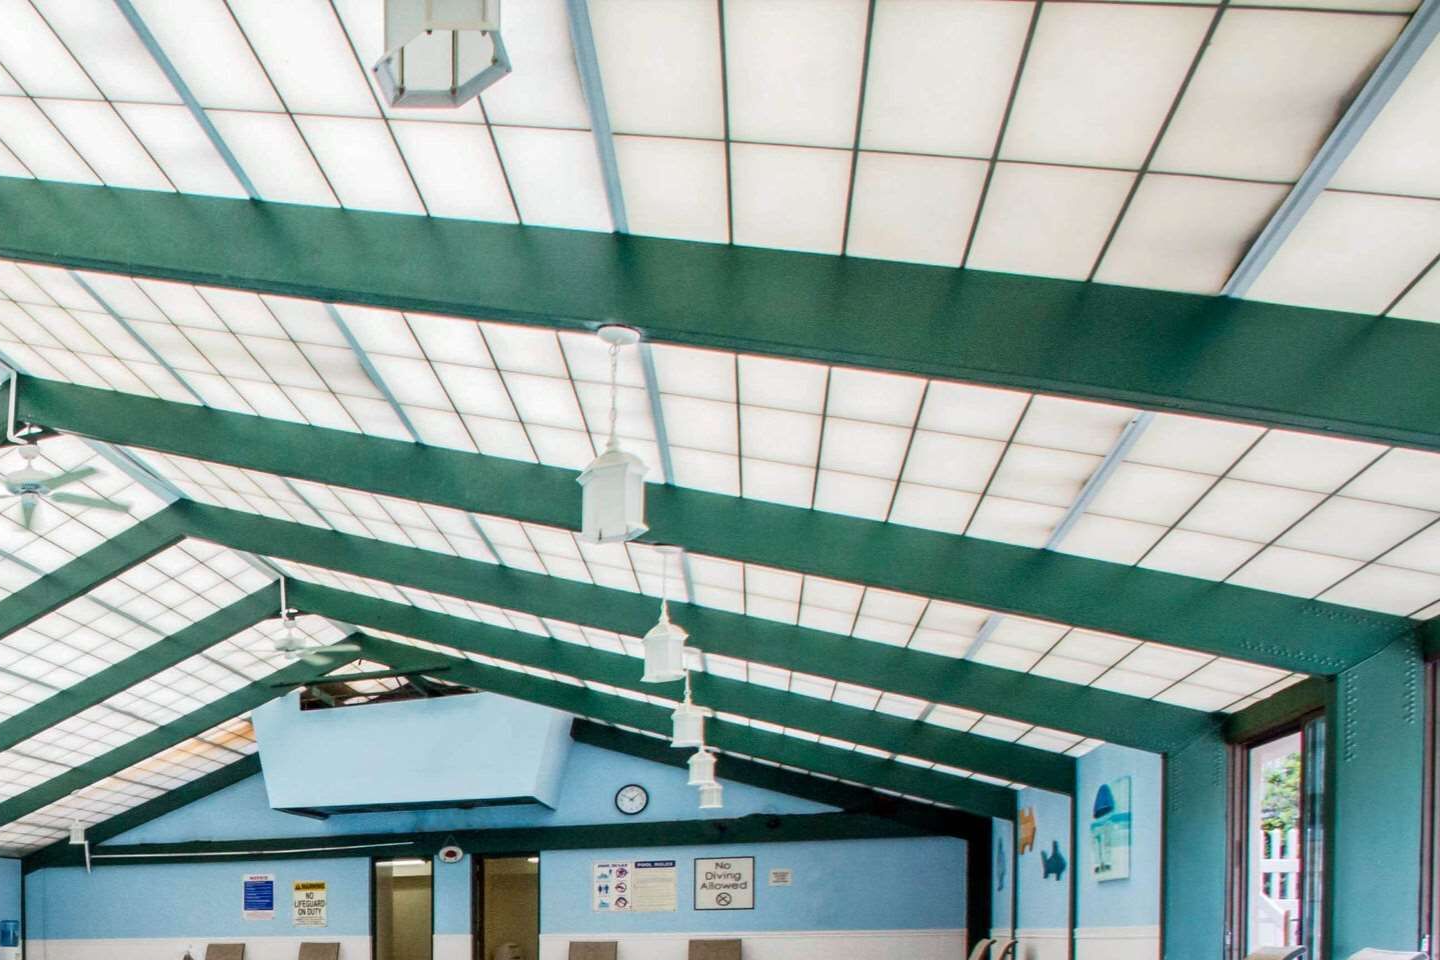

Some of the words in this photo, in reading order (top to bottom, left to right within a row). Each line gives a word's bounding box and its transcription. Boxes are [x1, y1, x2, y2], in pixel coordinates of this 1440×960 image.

[715, 862, 732, 870] No
[705, 871, 742, 881] Diving
[700, 881, 748, 890] Allowed
[305, 892, 314, 900] NO
[295, 900, 326, 908] LIFEGUARD
[298, 908, 306, 916] ON
[307, 908, 322, 916] DUTY
